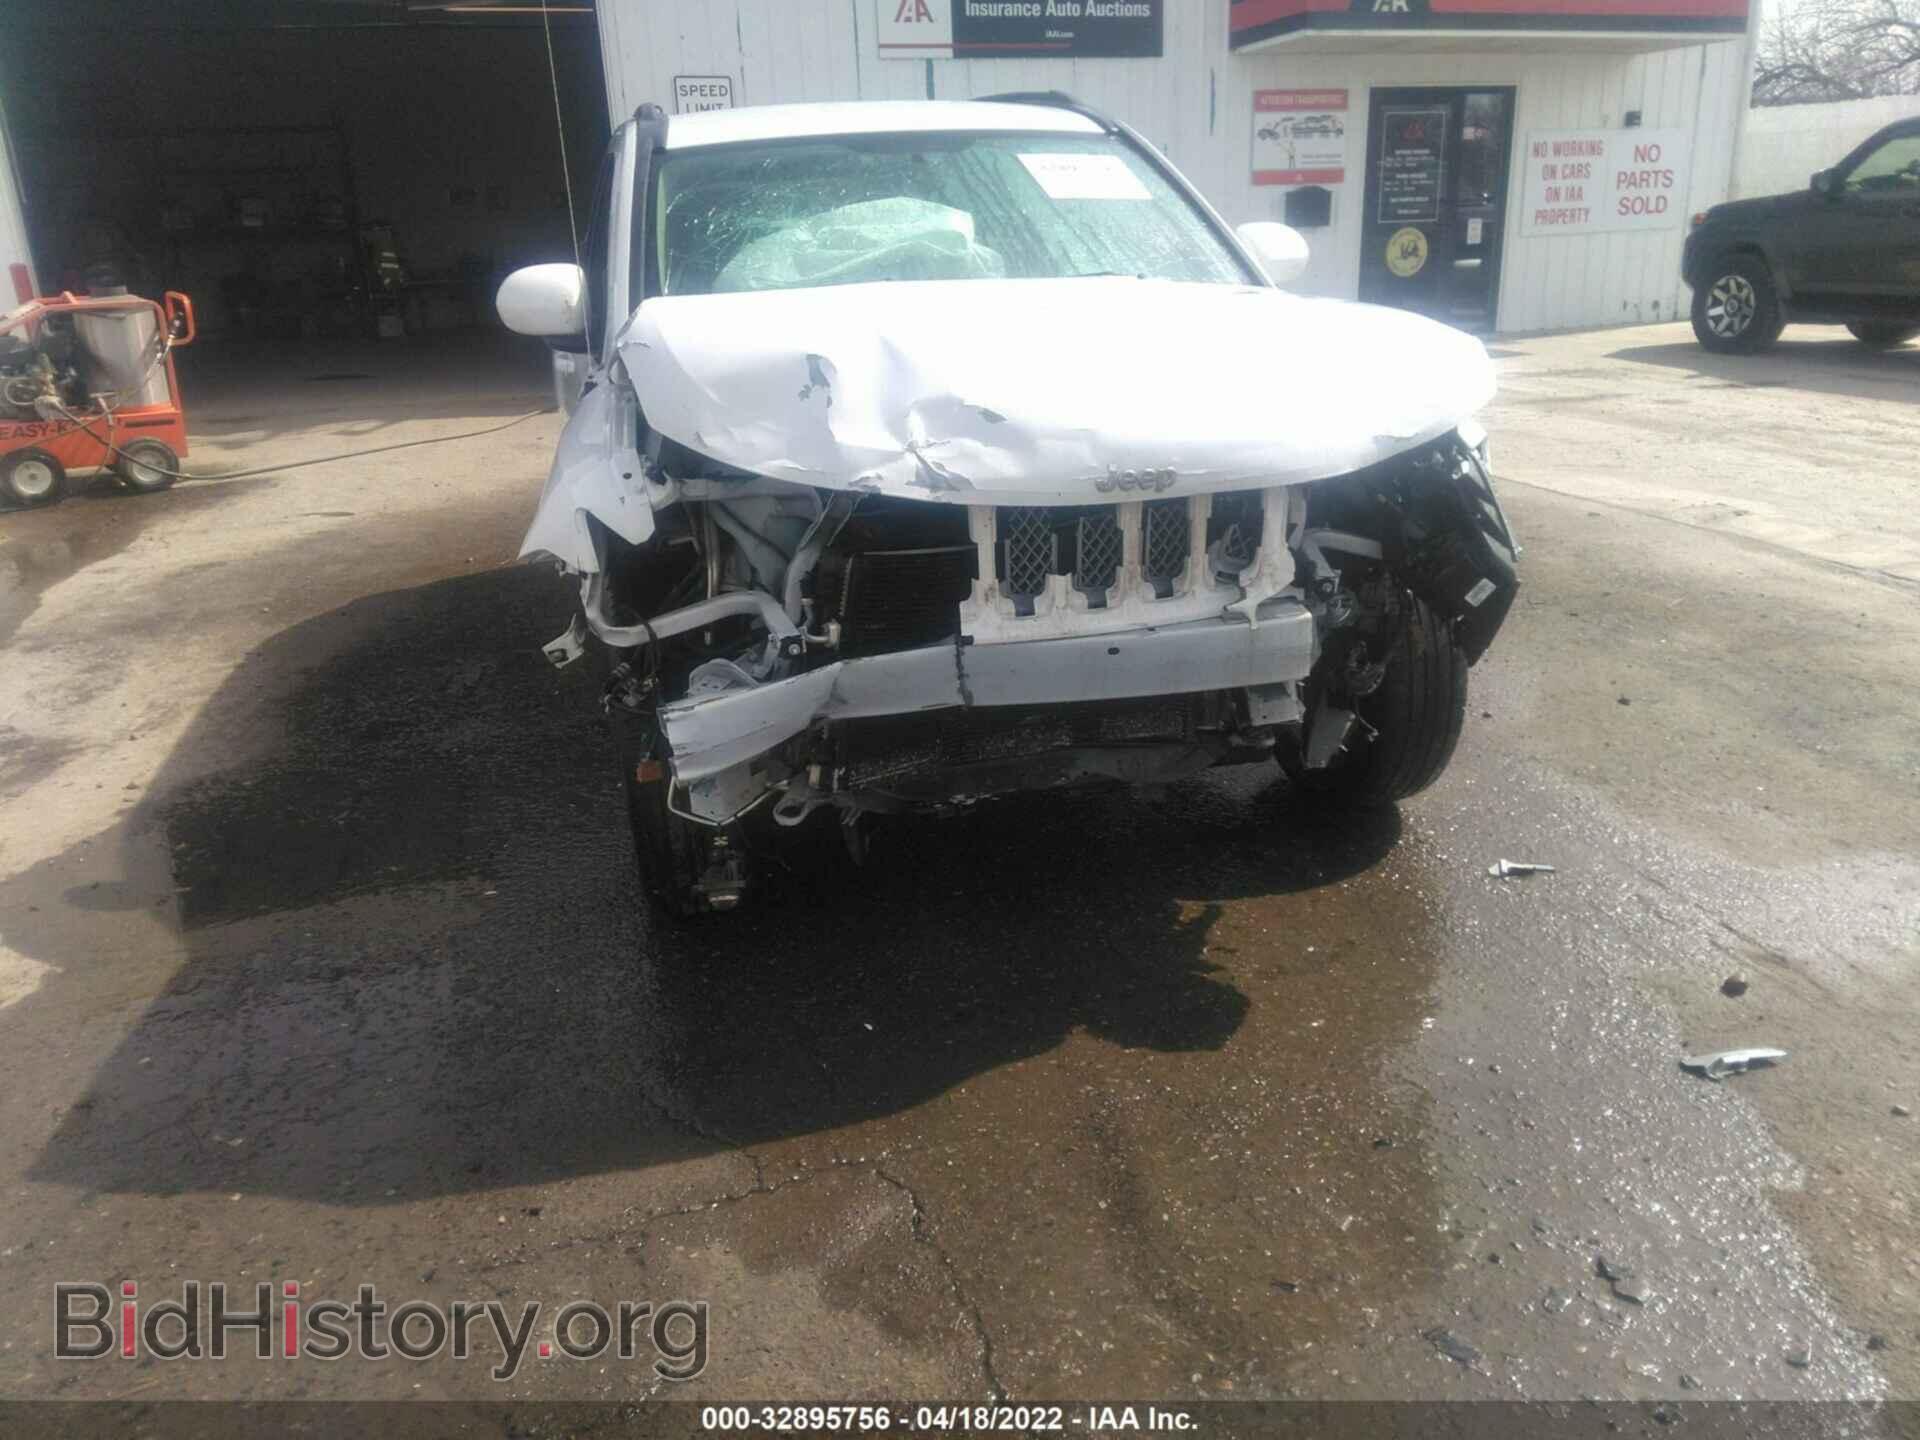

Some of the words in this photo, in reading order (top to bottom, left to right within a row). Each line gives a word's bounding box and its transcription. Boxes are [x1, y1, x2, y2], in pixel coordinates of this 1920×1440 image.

[965, 0, 1042, 17] Insurance
[1046, 0, 1082, 17] Auto
[1085, 0, 1151, 17] Auctions
[679, 84, 729, 97] SPEED
[1533, 141, 1548, 158] NO
[1552, 139, 1603, 157] WORKING
[1634, 143, 1661, 163] NO
[1542, 164, 1558, 181] ON
[1561, 162, 1591, 180] CARS
[1616, 169, 1674, 190] PARTS
[1545, 186, 1560, 203] ON
[1565, 186, 1584, 202] IAA
[1617, 195, 1668, 216] SOLD
[1535, 207, 1590, 224] PROPERTY
[1095, 463, 1177, 493] Jeep
